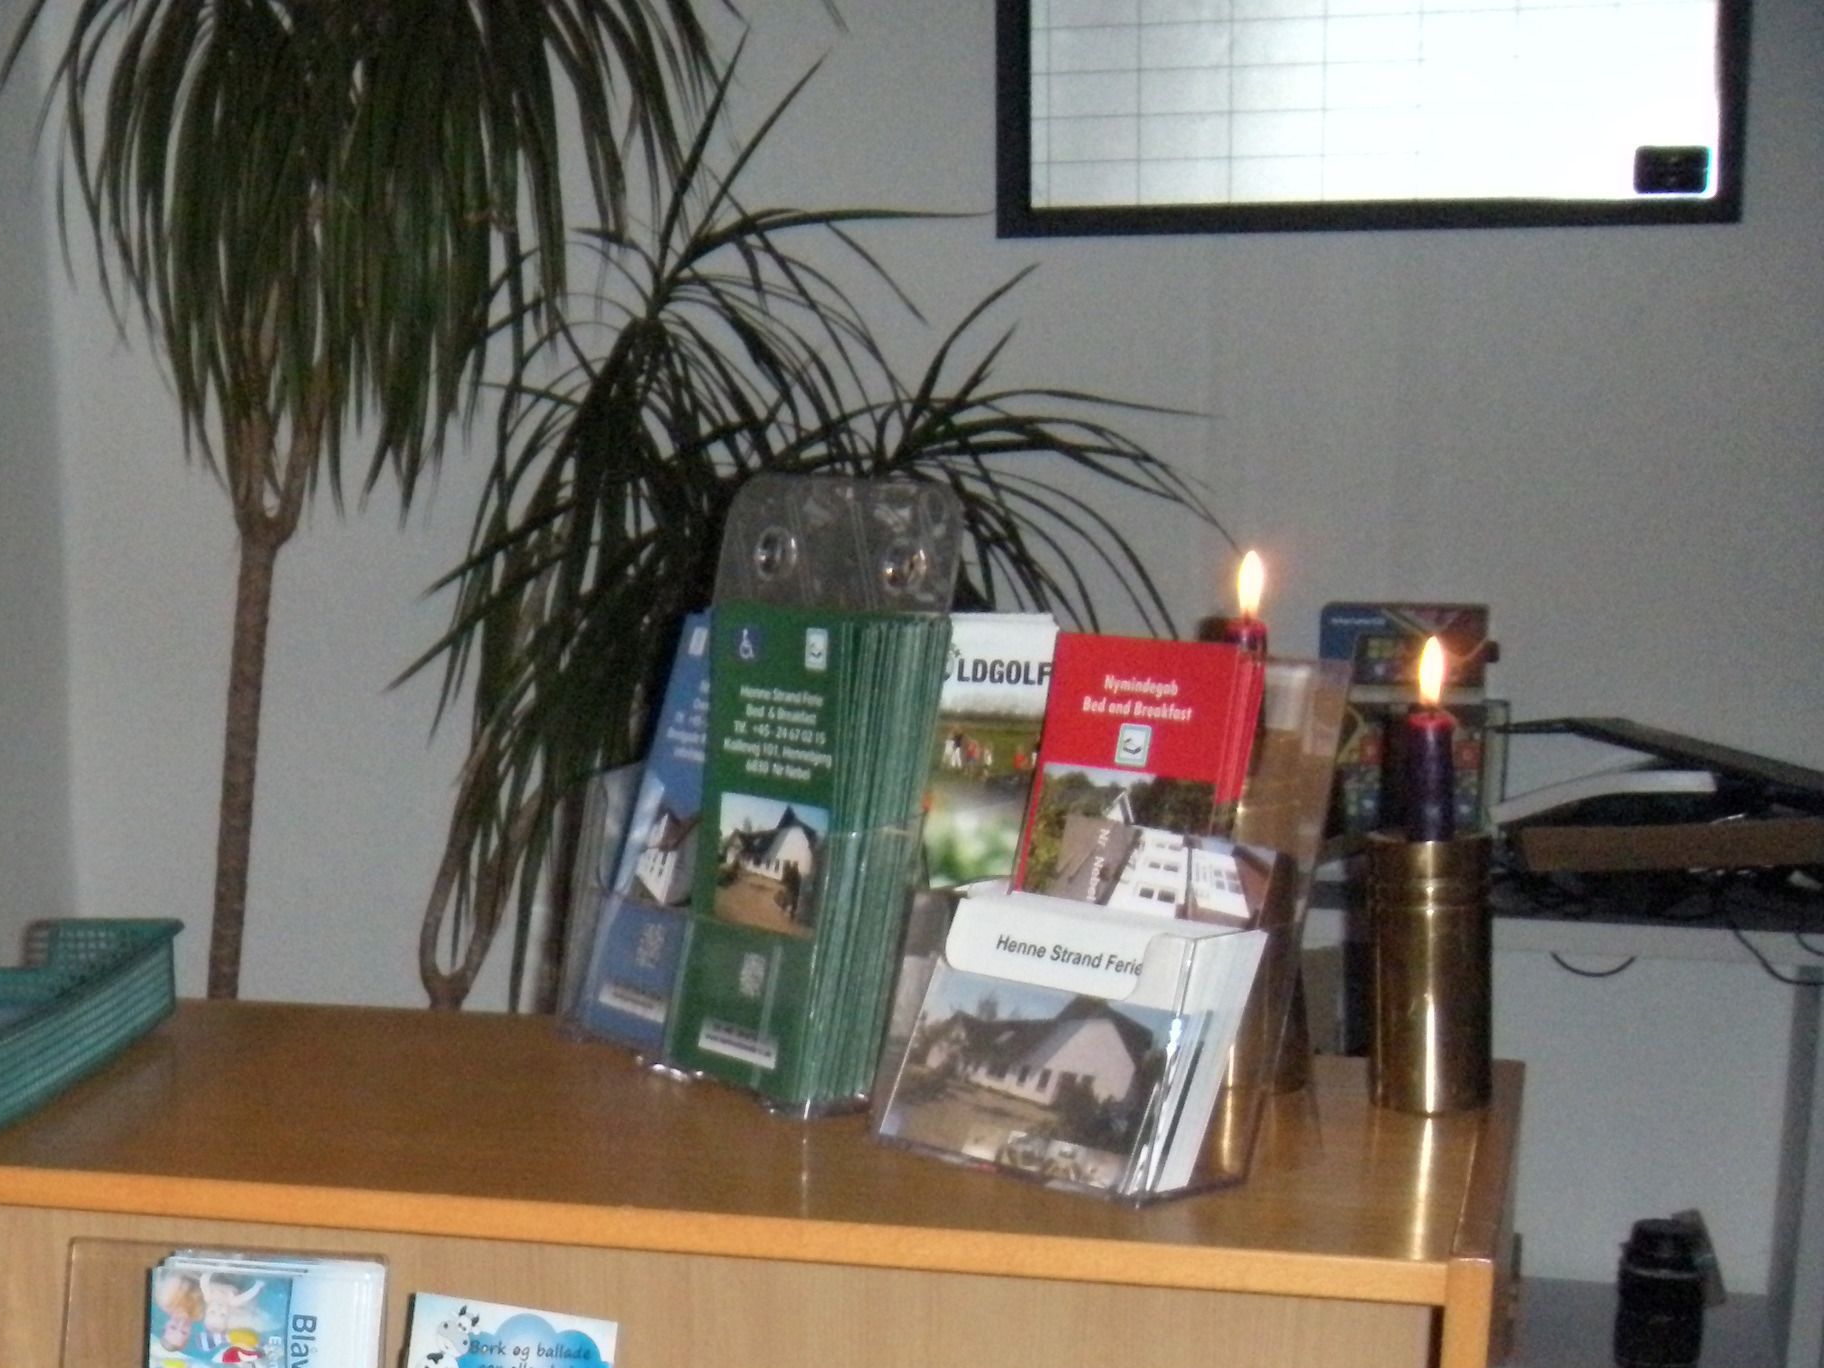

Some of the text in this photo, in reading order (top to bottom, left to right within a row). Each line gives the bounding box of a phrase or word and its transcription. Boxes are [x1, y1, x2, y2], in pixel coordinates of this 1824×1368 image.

[1104, 674, 1179, 698] Nymindegab
[1082, 696, 1192, 722] Bed and Breakfast
[996, 933, 1143, 977] Henne Strand Ferie
[469, 1339, 506, 1356] Bork
[537, 1342, 592, 1360] ballade
